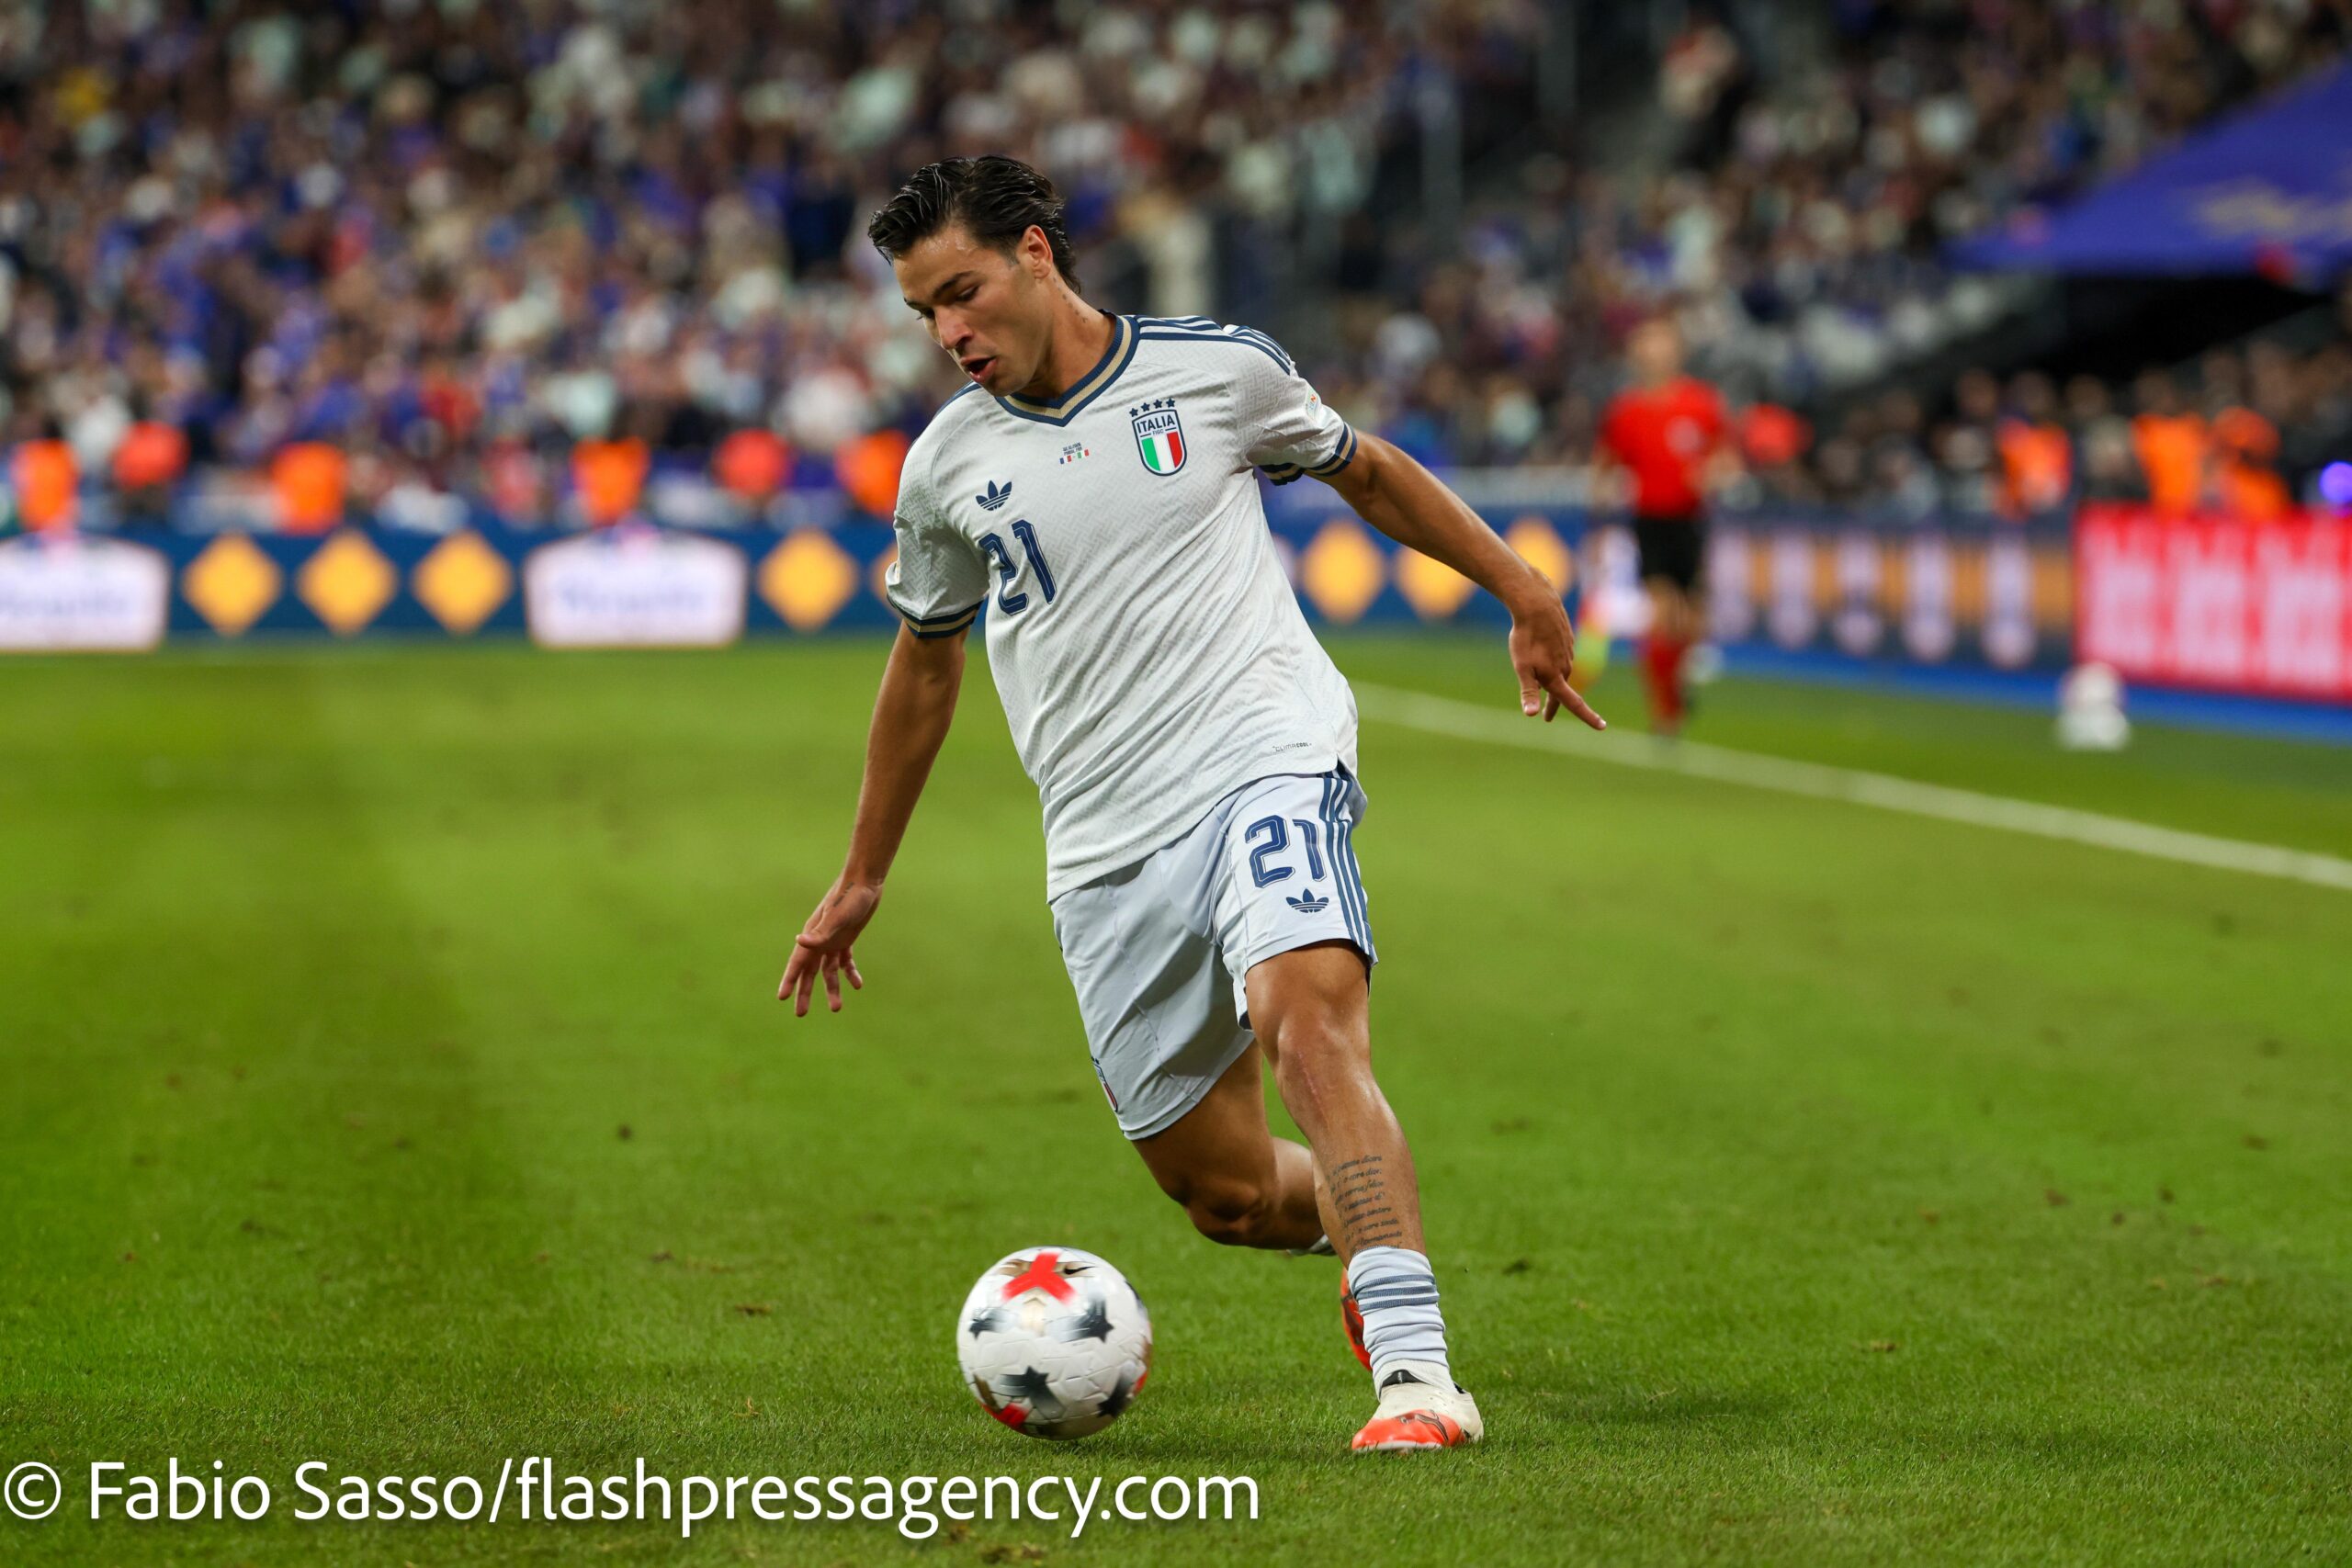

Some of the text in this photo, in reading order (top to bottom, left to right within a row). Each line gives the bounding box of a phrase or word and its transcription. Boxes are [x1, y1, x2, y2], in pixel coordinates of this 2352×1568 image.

[1136, 414, 1175, 434] ITALIA
[978, 519, 1057, 616] 21
[1244, 815, 1327, 888] 21
